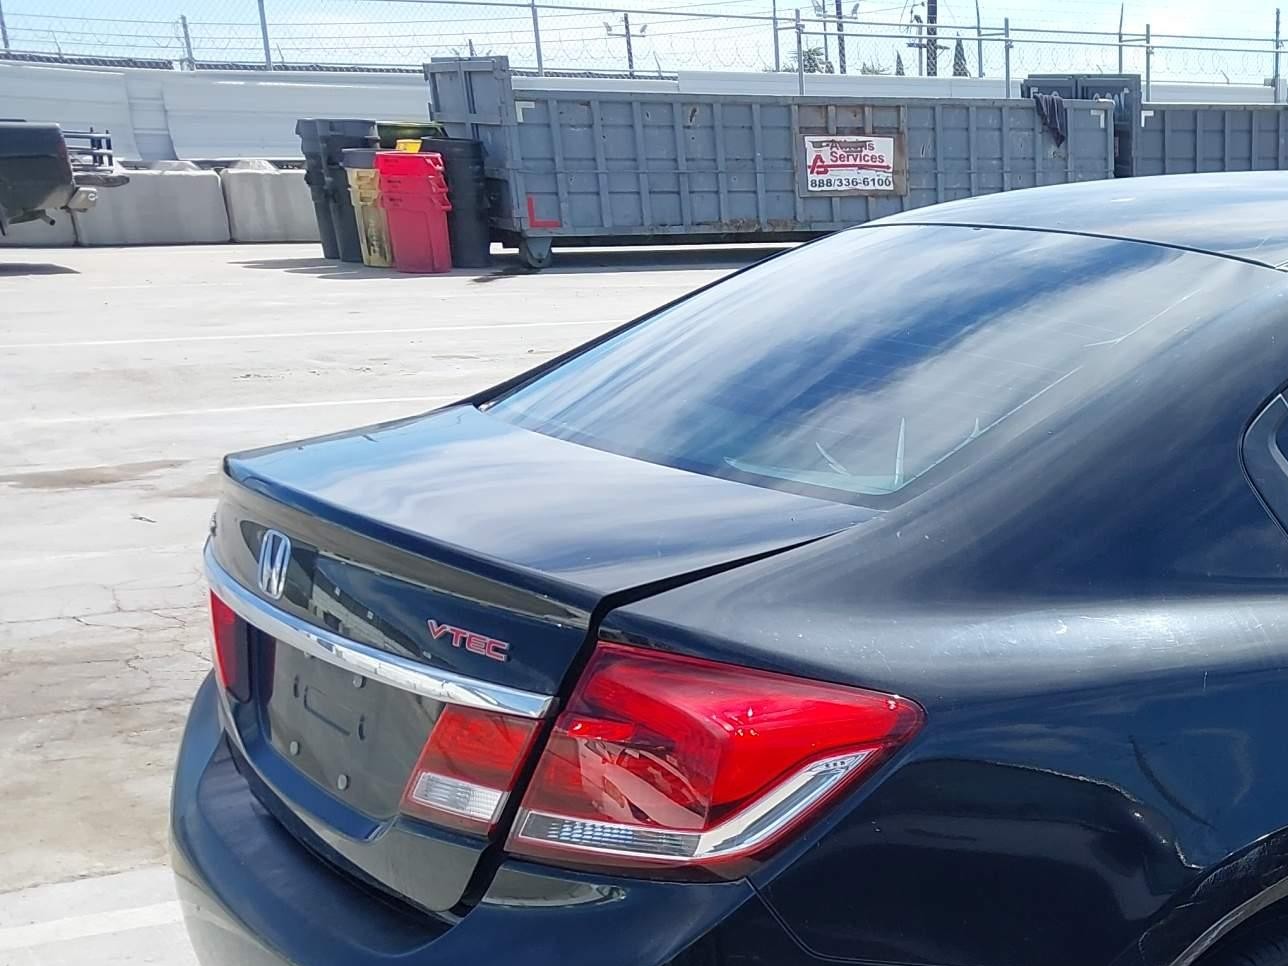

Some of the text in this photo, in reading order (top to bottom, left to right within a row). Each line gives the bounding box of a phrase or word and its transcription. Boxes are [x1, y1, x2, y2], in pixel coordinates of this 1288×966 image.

[829, 151, 885, 164] Services
[810, 177, 891, 188] 888/336-6100
[427, 619, 510, 662] VTEC
